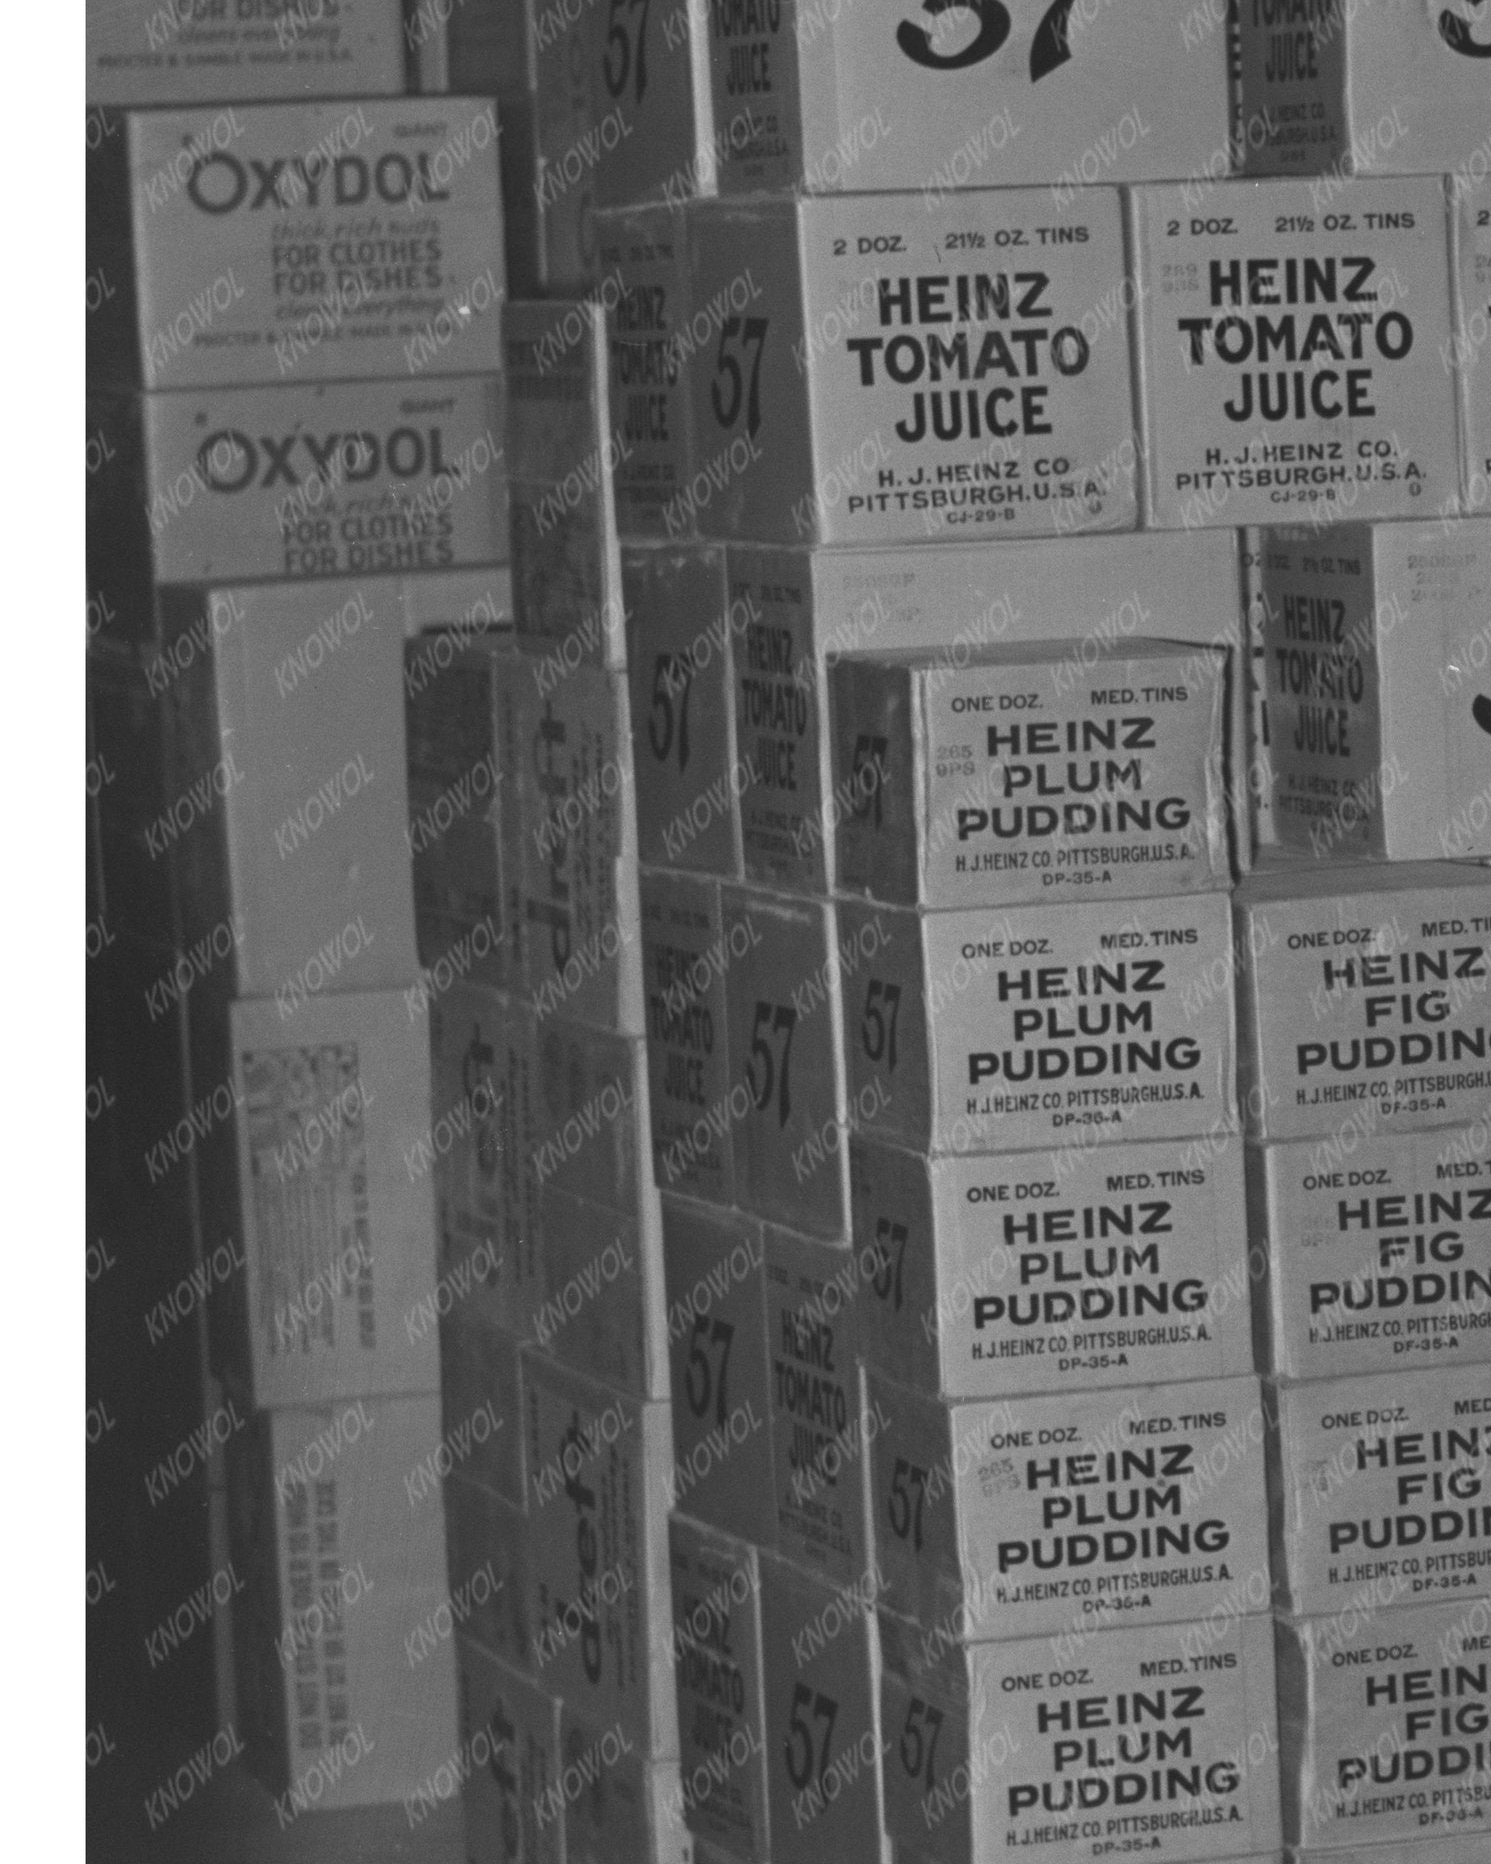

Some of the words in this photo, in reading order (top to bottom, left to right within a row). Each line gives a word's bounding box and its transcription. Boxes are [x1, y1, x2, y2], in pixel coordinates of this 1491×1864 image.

[187, 150, 451, 215] OXYDOL
[834, 239, 846, 255] 2
[858, 235, 906, 254] DOZ.
[995, 230, 1028, 246] OZ.
[1036, 226, 1089, 244] TINS
[879, 272, 1052, 326] HEINZ
[847, 327, 1089, 386] TOMATO
[896, 386, 1052, 442] JUICE
[196, 426, 458, 494] OXYDOL
[951, 696, 993, 713] ONE
[999, 694, 1043, 710] DOZ.
[1091, 689, 1139, 704] MED.
[1141, 686, 1188, 702] TINS
[987, 717, 1155, 756] HEINZ
[1004, 759, 1141, 798] PLUM
[958, 797, 1190, 841] PUDDING
[1042, 870, 1112, 886] DP-35-A
[1365, 990, 1450, 1027] FIG
